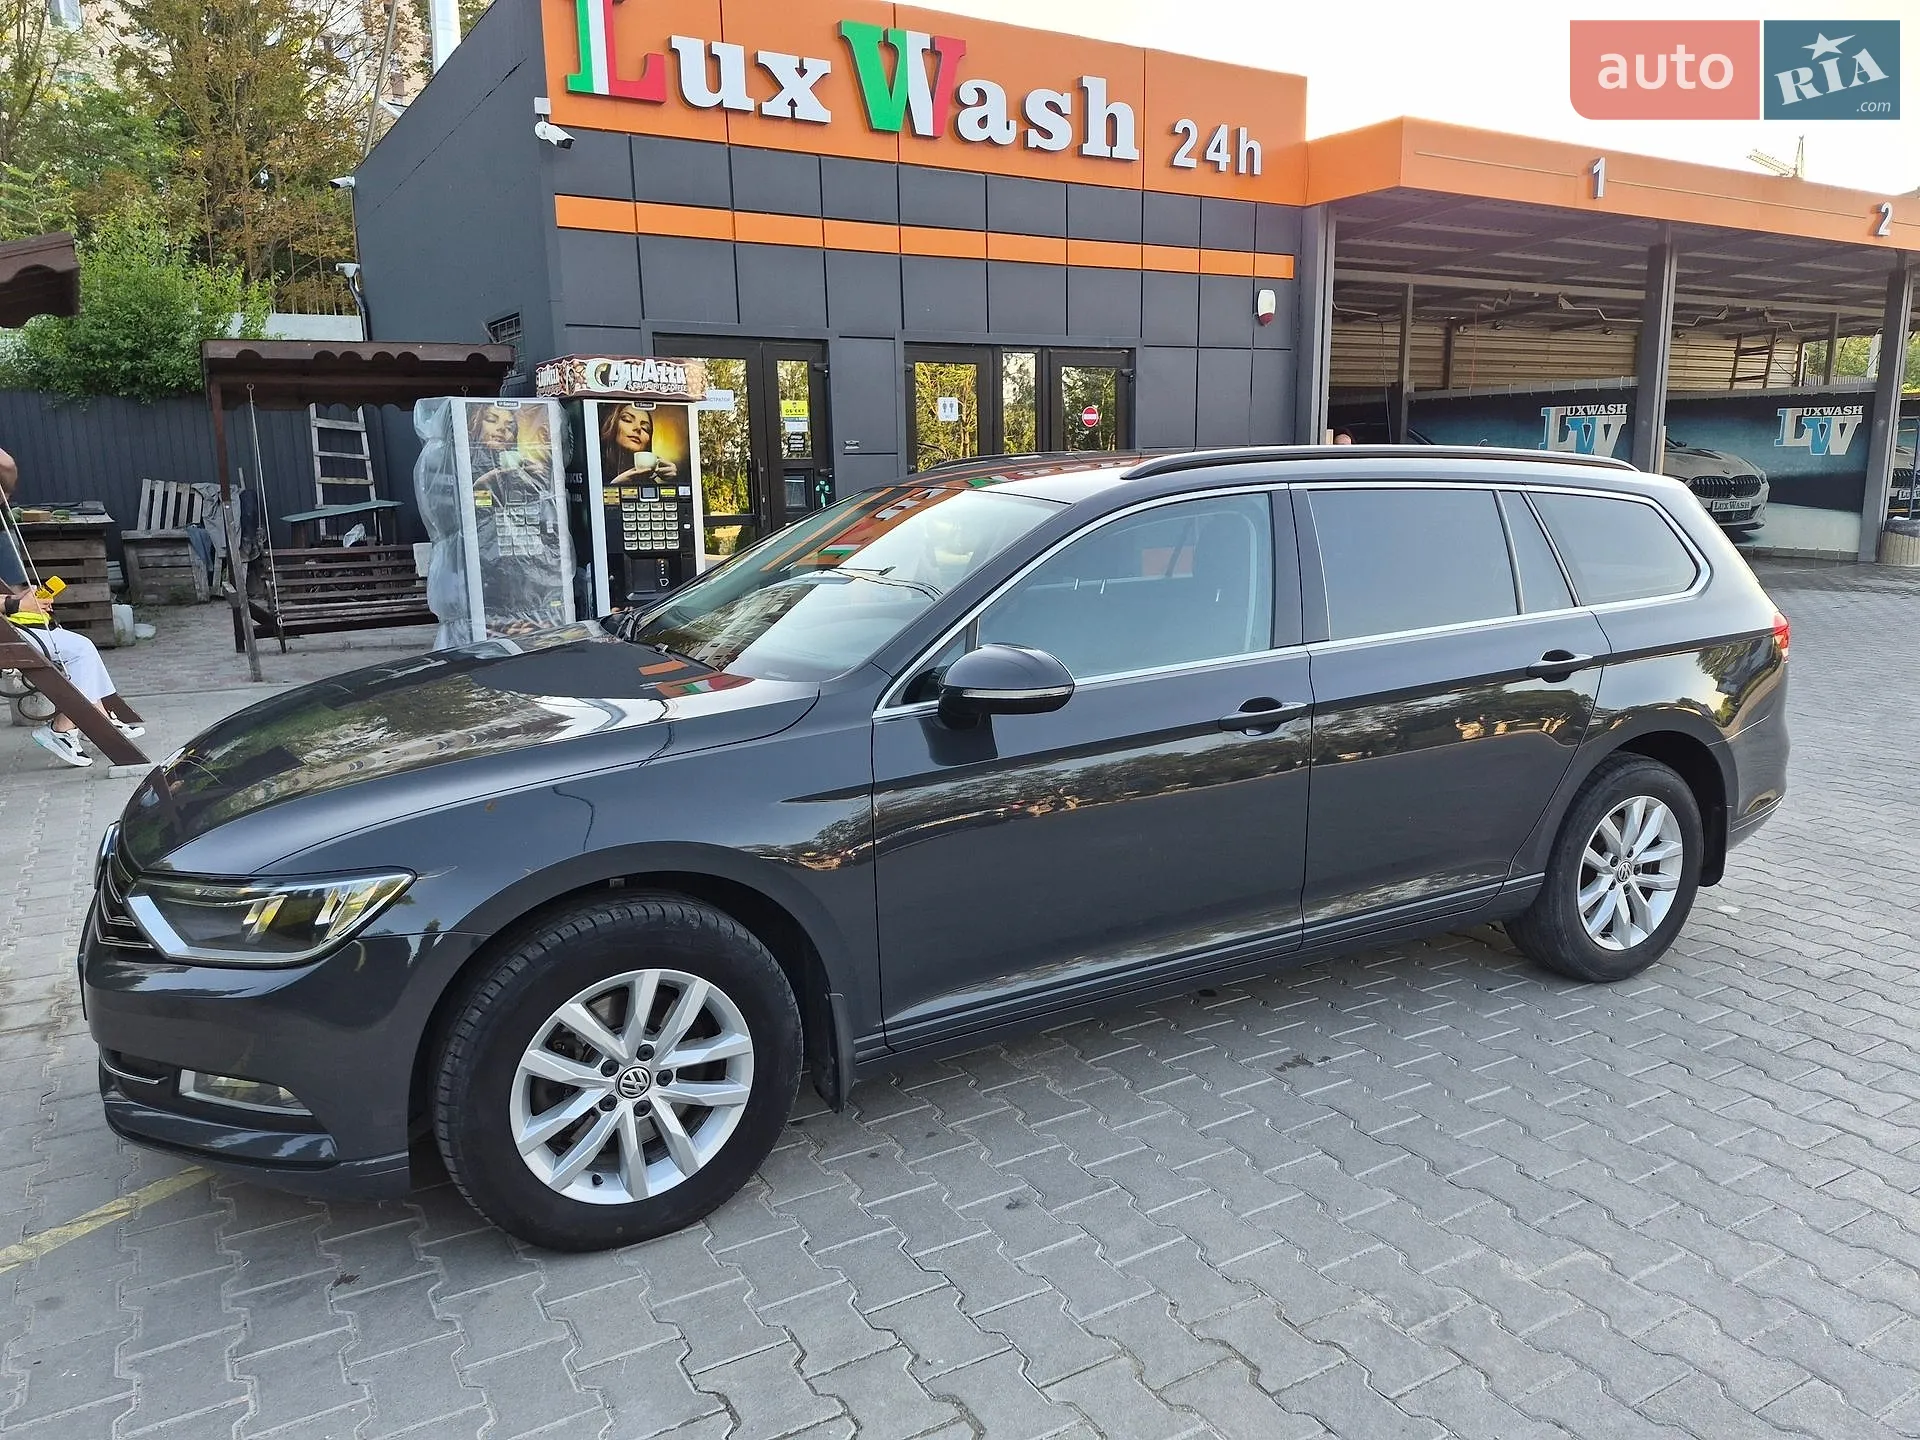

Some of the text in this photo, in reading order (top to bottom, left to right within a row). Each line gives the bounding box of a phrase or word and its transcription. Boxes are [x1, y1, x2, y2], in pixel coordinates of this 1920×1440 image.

[1170, 118, 1263, 176] 24h
[1591, 155, 1607, 200] 1
[1874, 201, 1894, 238] 2
